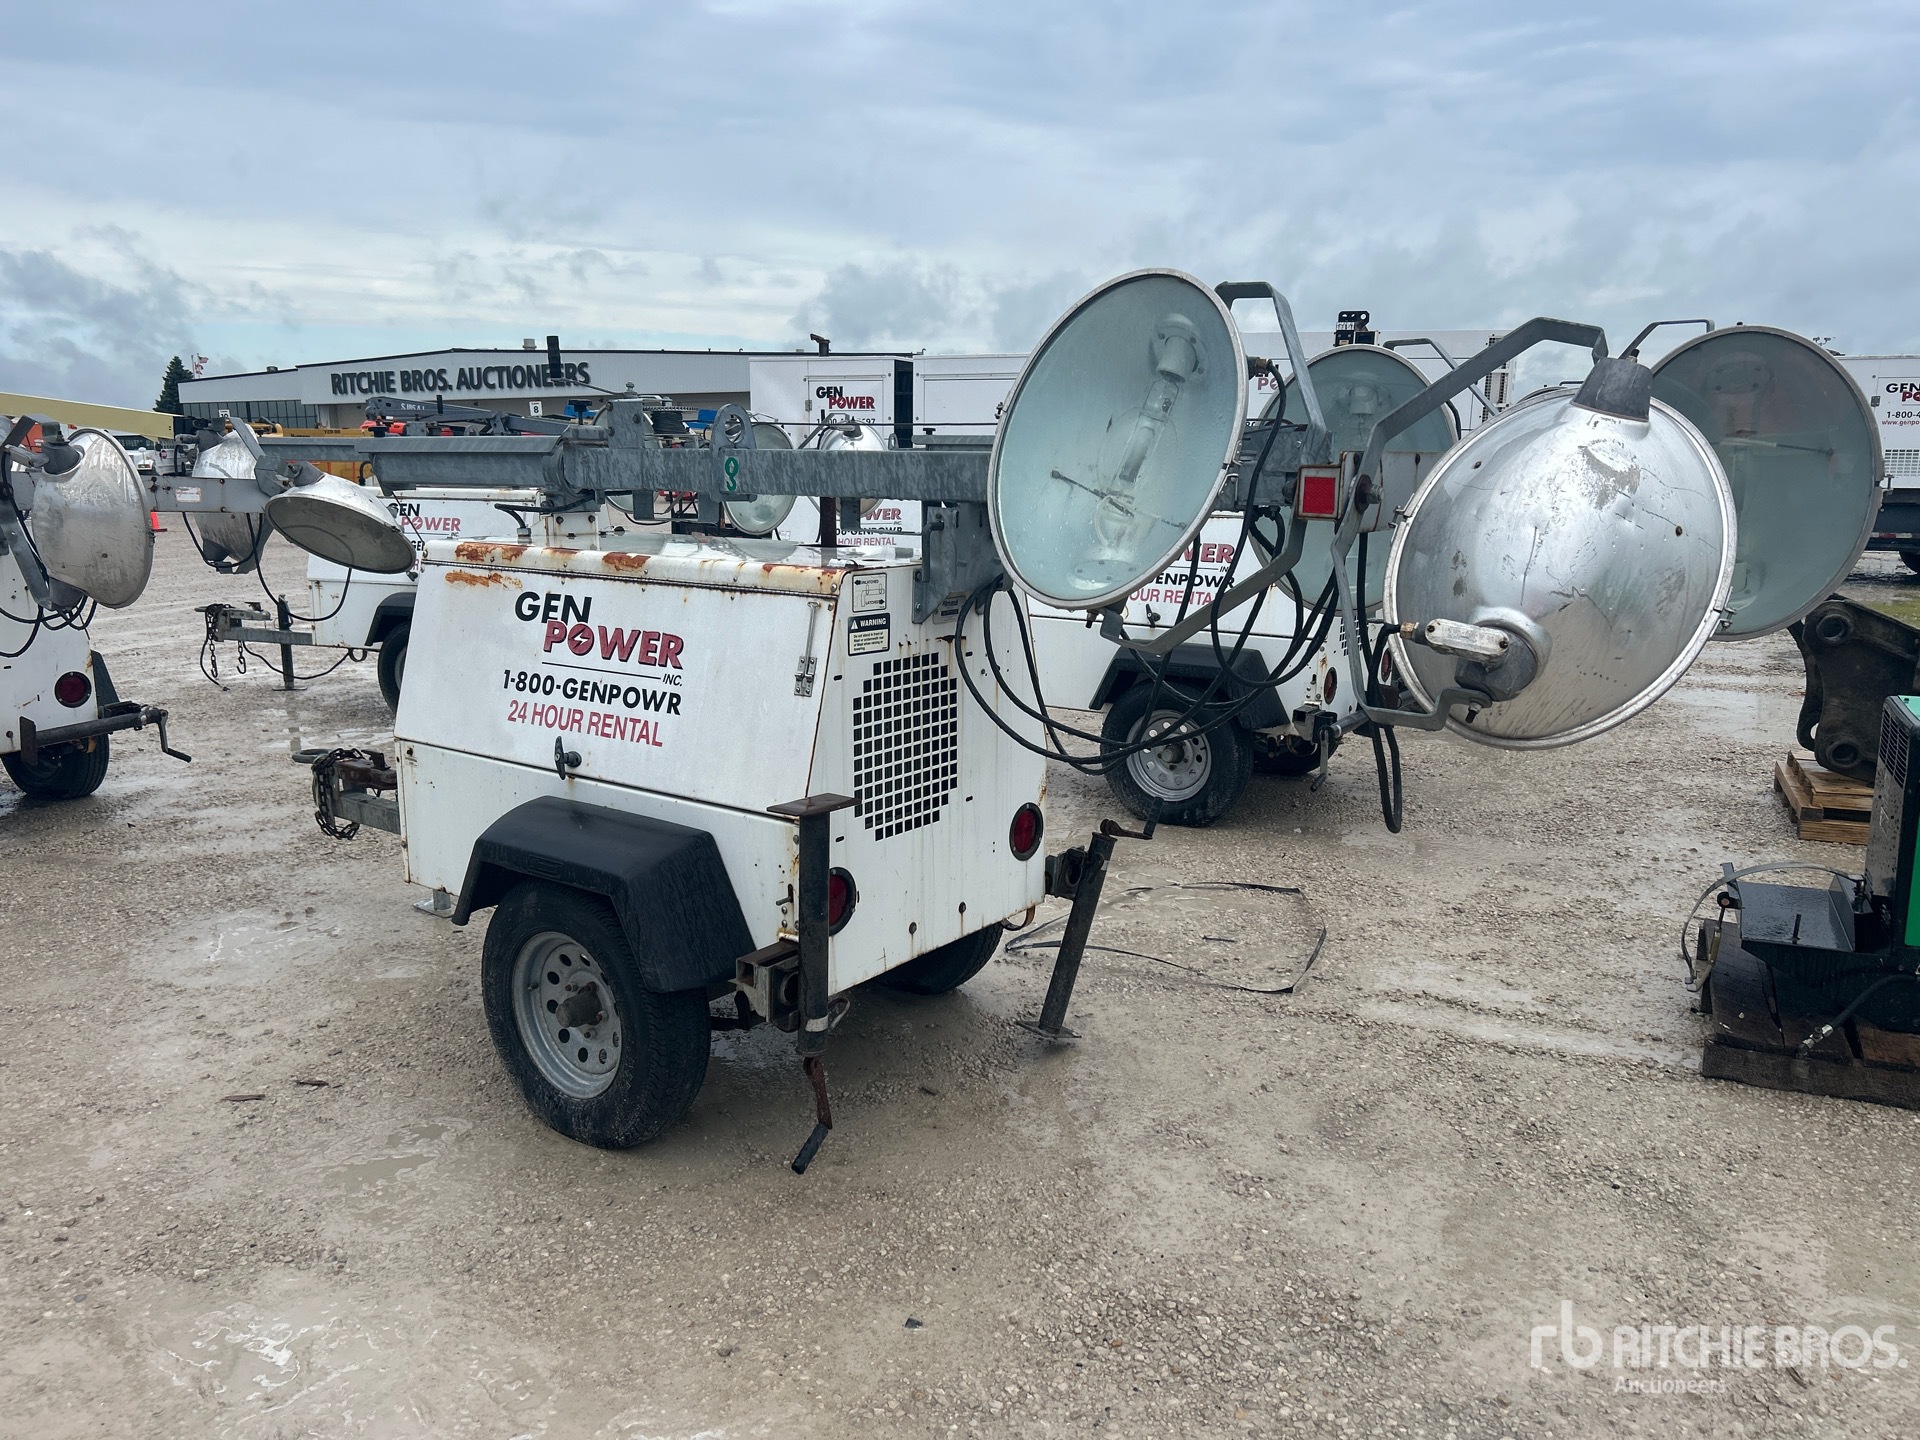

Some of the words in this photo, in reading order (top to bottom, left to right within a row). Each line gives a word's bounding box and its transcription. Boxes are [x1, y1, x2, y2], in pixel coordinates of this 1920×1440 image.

[331, 370, 396, 395] RITCHIE
[400, 368, 453, 392] BROS.
[1886, 383, 1920, 393] GEN
[816, 386, 843, 398] GEN
[828, 396, 875, 409] POWER
[533, 405, 539, 414] 8
[864, 507, 902, 520] WER
[401, 516, 461, 532] POWER
[864, 537, 897, 546] RENTAL
[1129, 588, 1160, 601] OUR
[515, 591, 592, 626] GEN
[860, 617, 887, 628] WARNING
[543, 619, 684, 670] POWER
[662, 673, 683, 687] INC.
[503, 669, 682, 716] 1-800-GENPOWR
[507, 699, 528, 724] 24
[531, 702, 584, 733] HOUR
[586, 711, 663, 748] RENTAL
